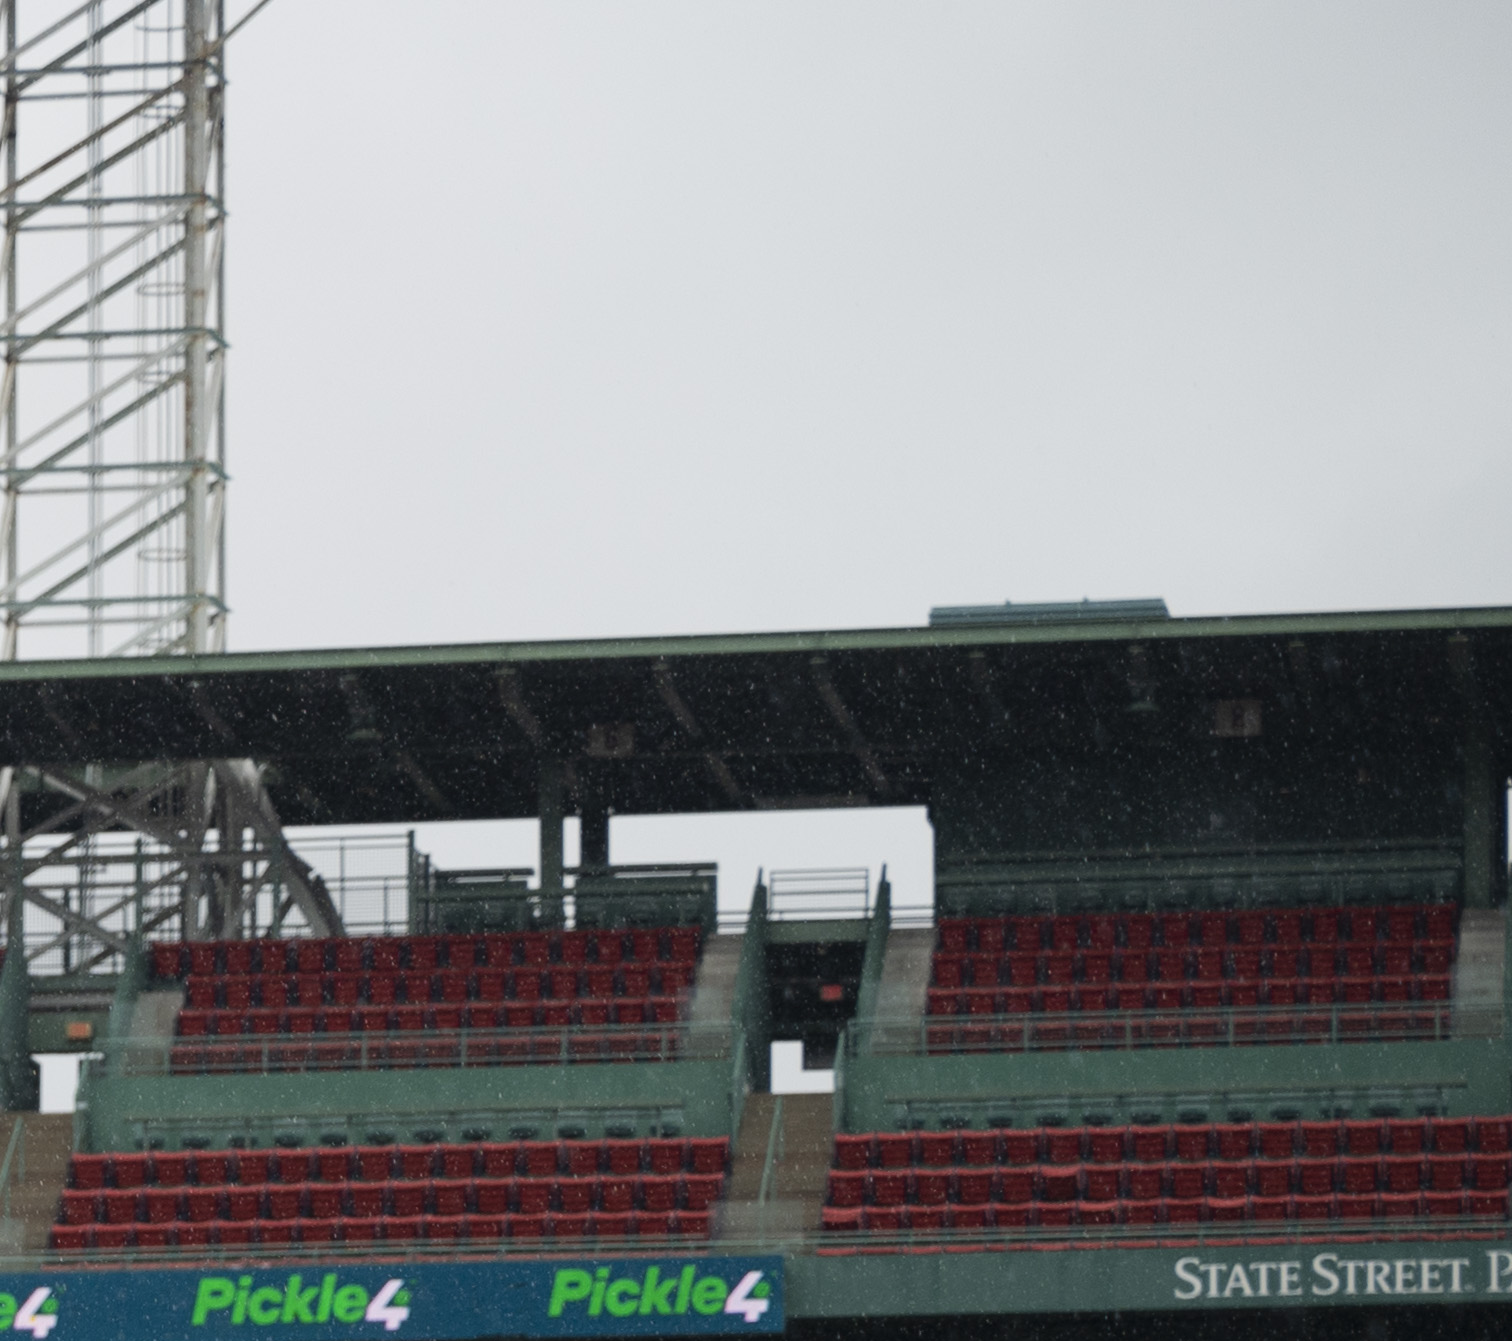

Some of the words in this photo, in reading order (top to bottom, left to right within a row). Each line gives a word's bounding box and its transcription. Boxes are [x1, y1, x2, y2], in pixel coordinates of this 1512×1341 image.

[191, 1274, 410, 1331] Pickle4
[548, 1265, 770, 1322] Pickle4
[1173, 1256, 1302, 1300] STATE
[1311, 1252, 1470, 1297] STREET
